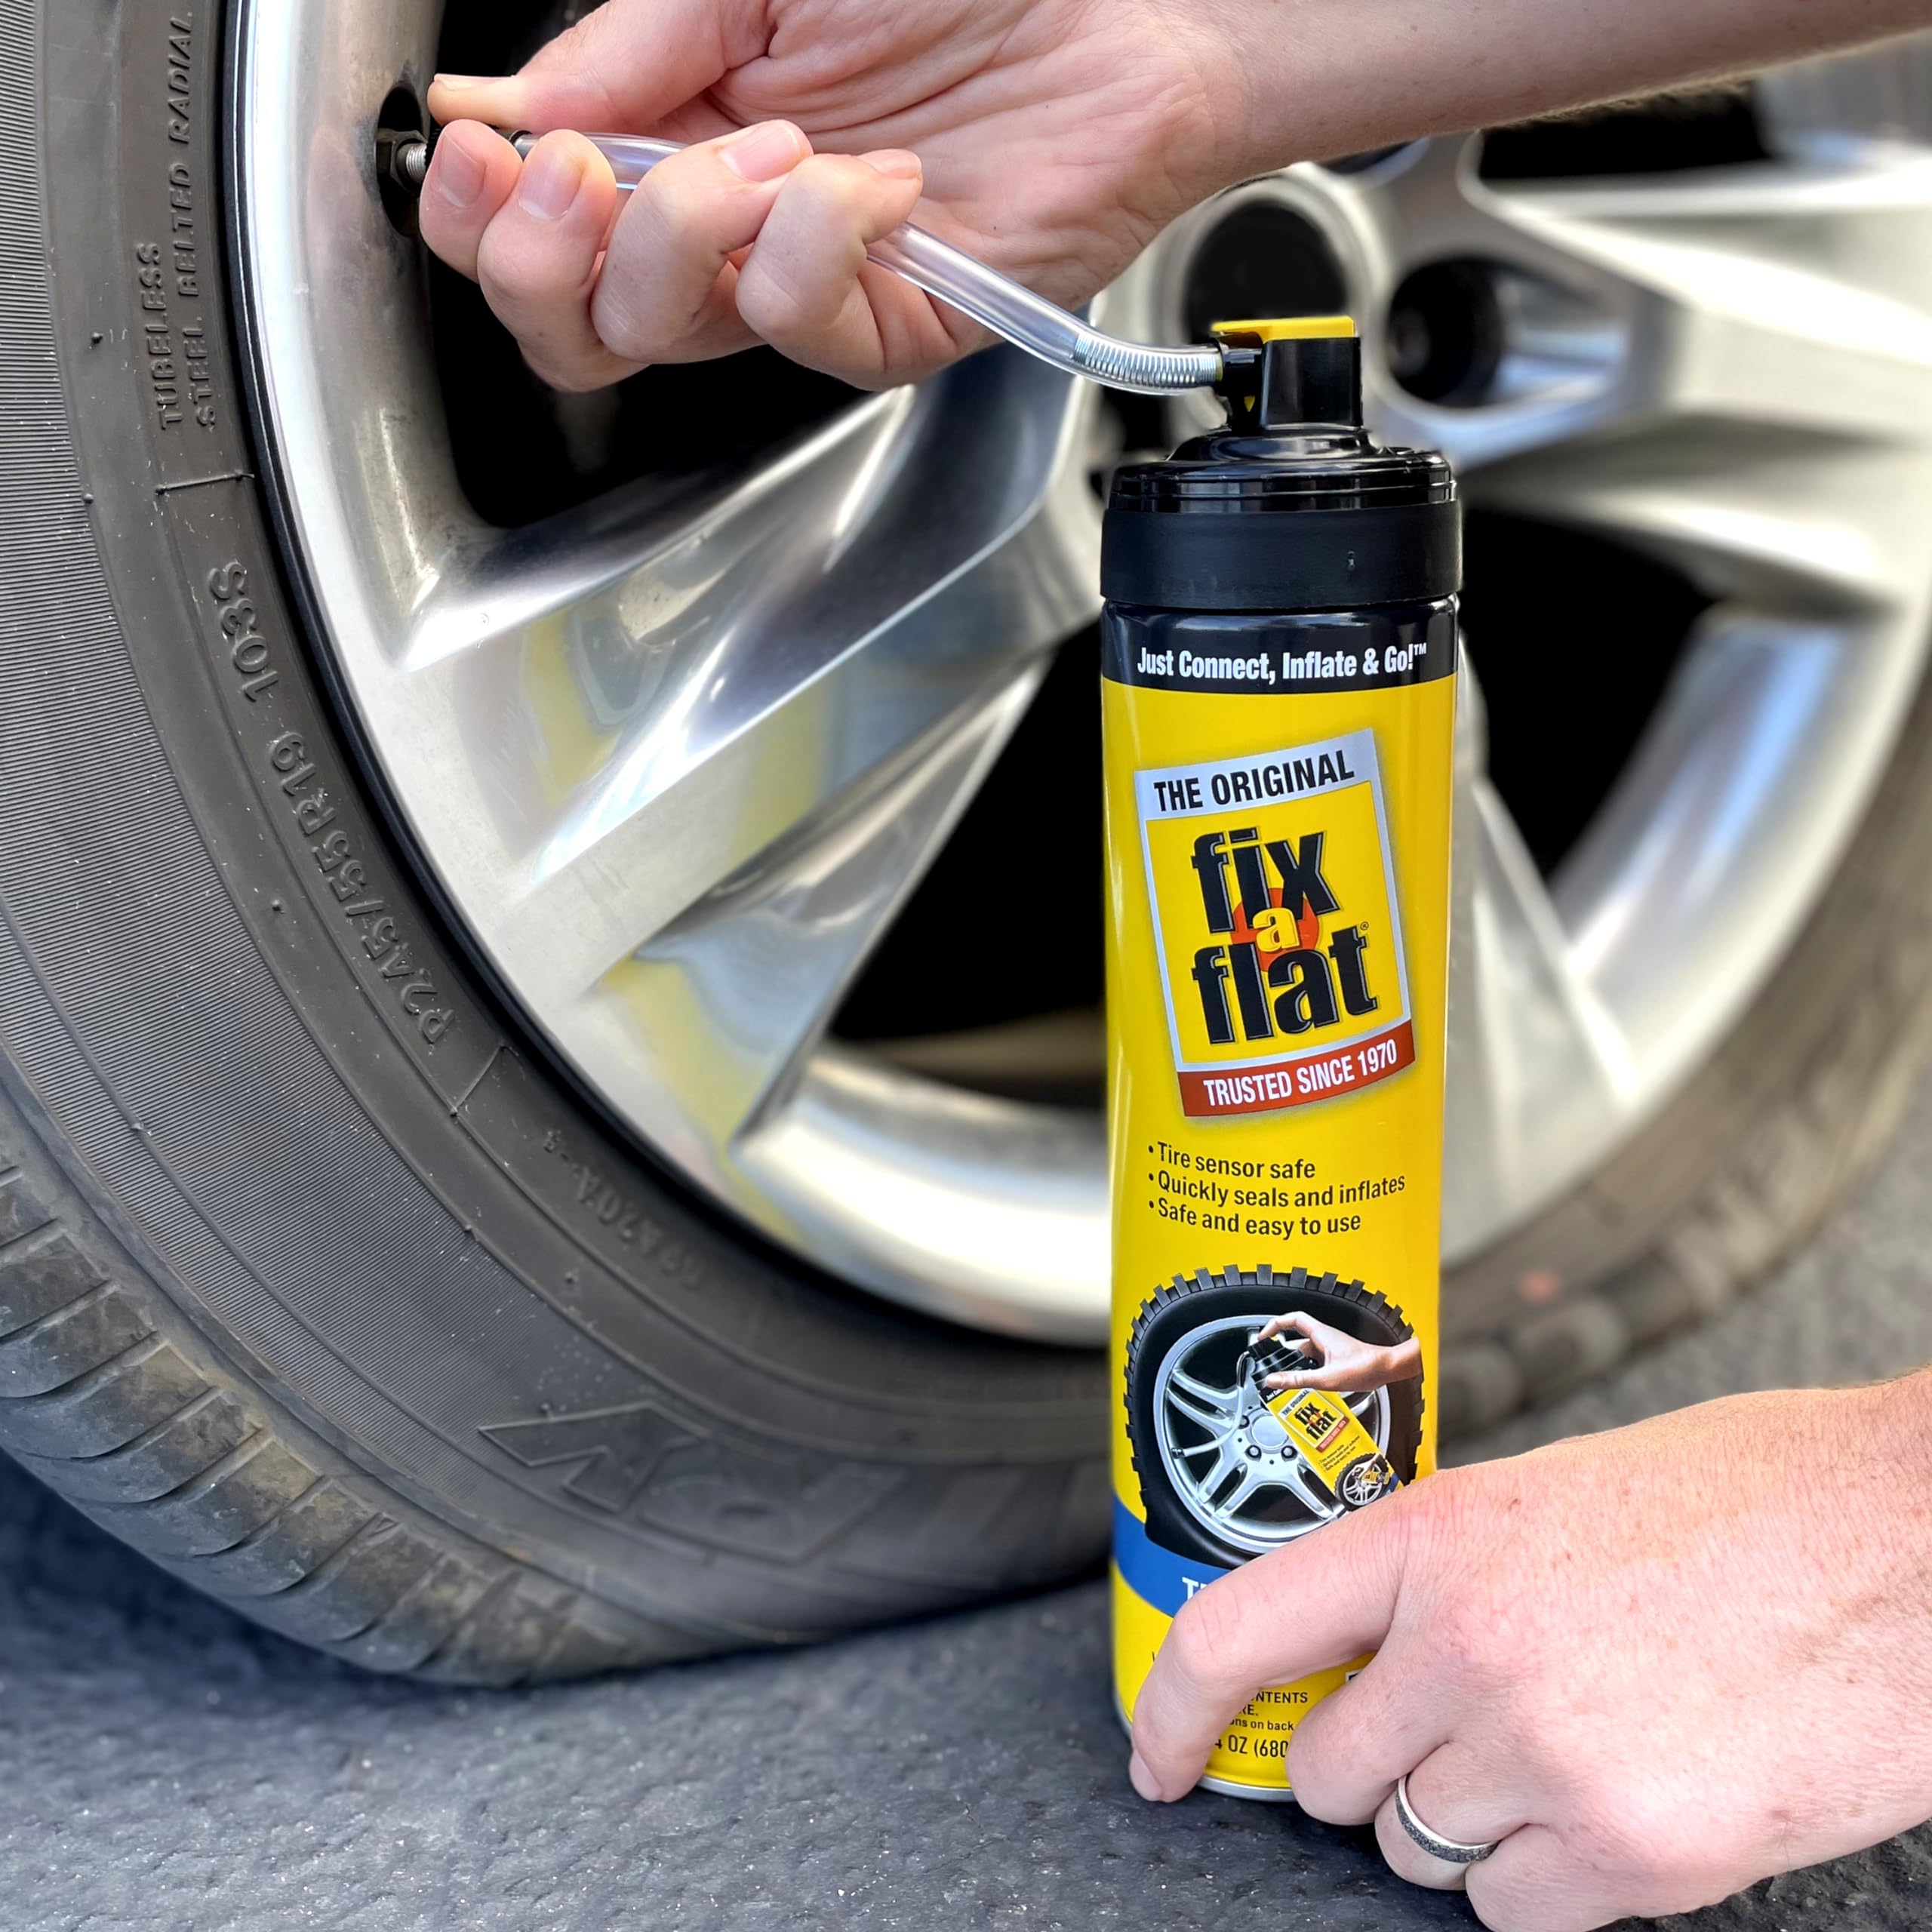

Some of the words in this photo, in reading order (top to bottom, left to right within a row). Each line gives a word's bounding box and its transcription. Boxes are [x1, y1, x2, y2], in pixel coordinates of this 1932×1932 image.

[168, 11, 193, 144] RADIAL
[168, 162, 198, 297] BELTED
[137, 242, 183, 429] TUBELESS
[183, 317, 217, 428] STEEL
[209, 561, 279, 703] 103S
[1137, 647, 1174, 675] Just
[1179, 650, 1275, 685] Connect,
[1283, 651, 1356, 678] Inflate
[1362, 648, 1379, 675] &
[1154, 777, 1204, 811] THE
[1211, 750, 1355, 804] ORIGINAL
[1190, 826, 1341, 934] fix
[1252, 907, 1300, 952] a
[1203, 1072, 1292, 1106] TRUSTED
[1297, 1055, 1355, 1094] SINCE
[1358, 1038, 1398, 1077] 1970
[1158, 1141, 1190, 1168] Tire
[1195, 1155, 1265, 1178] sensor
[1269, 1158, 1316, 1179] safe
[1158, 1170, 1229, 1208] Quickly
[1234, 1188, 1289, 1208] seals
[1294, 1186, 1333, 1207] and
[1339, 1174, 1405, 1205] inflates
[1158, 1197, 1197, 1226] Safe
[1201, 1211, 1239, 1232] and
[1245, 1218, 1294, 1240] easy
[1300, 1217, 1321, 1235] to
[1327, 1214, 1361, 1233] use
[1294, 1401, 1321, 1426] fix
[1251, 1690, 1309, 1704] NTENTS
[1227, 1734, 1248, 1755] OZ
[1250, 1720, 1264, 1730] on
[1267, 1720, 1294, 1731] back
